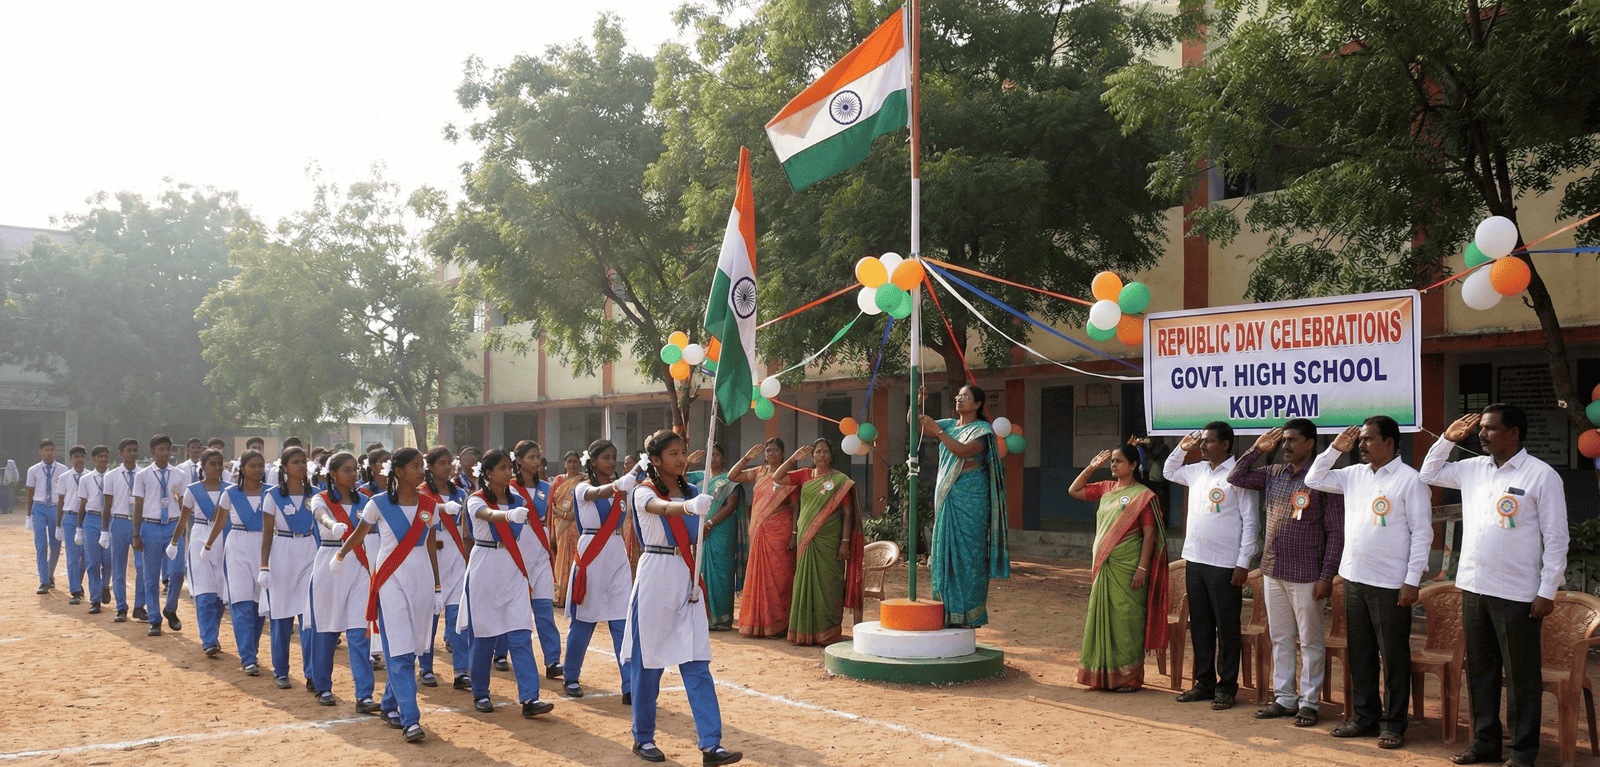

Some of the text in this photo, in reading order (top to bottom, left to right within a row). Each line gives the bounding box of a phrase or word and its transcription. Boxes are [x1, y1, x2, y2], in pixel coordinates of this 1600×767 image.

[1158, 310, 1402, 356] REPUBLIC DAY CELEBRATIONS
[1171, 357, 1387, 389] GOVT. HIGH SCHOOL
[1229, 394, 1319, 419] KUPPAM
